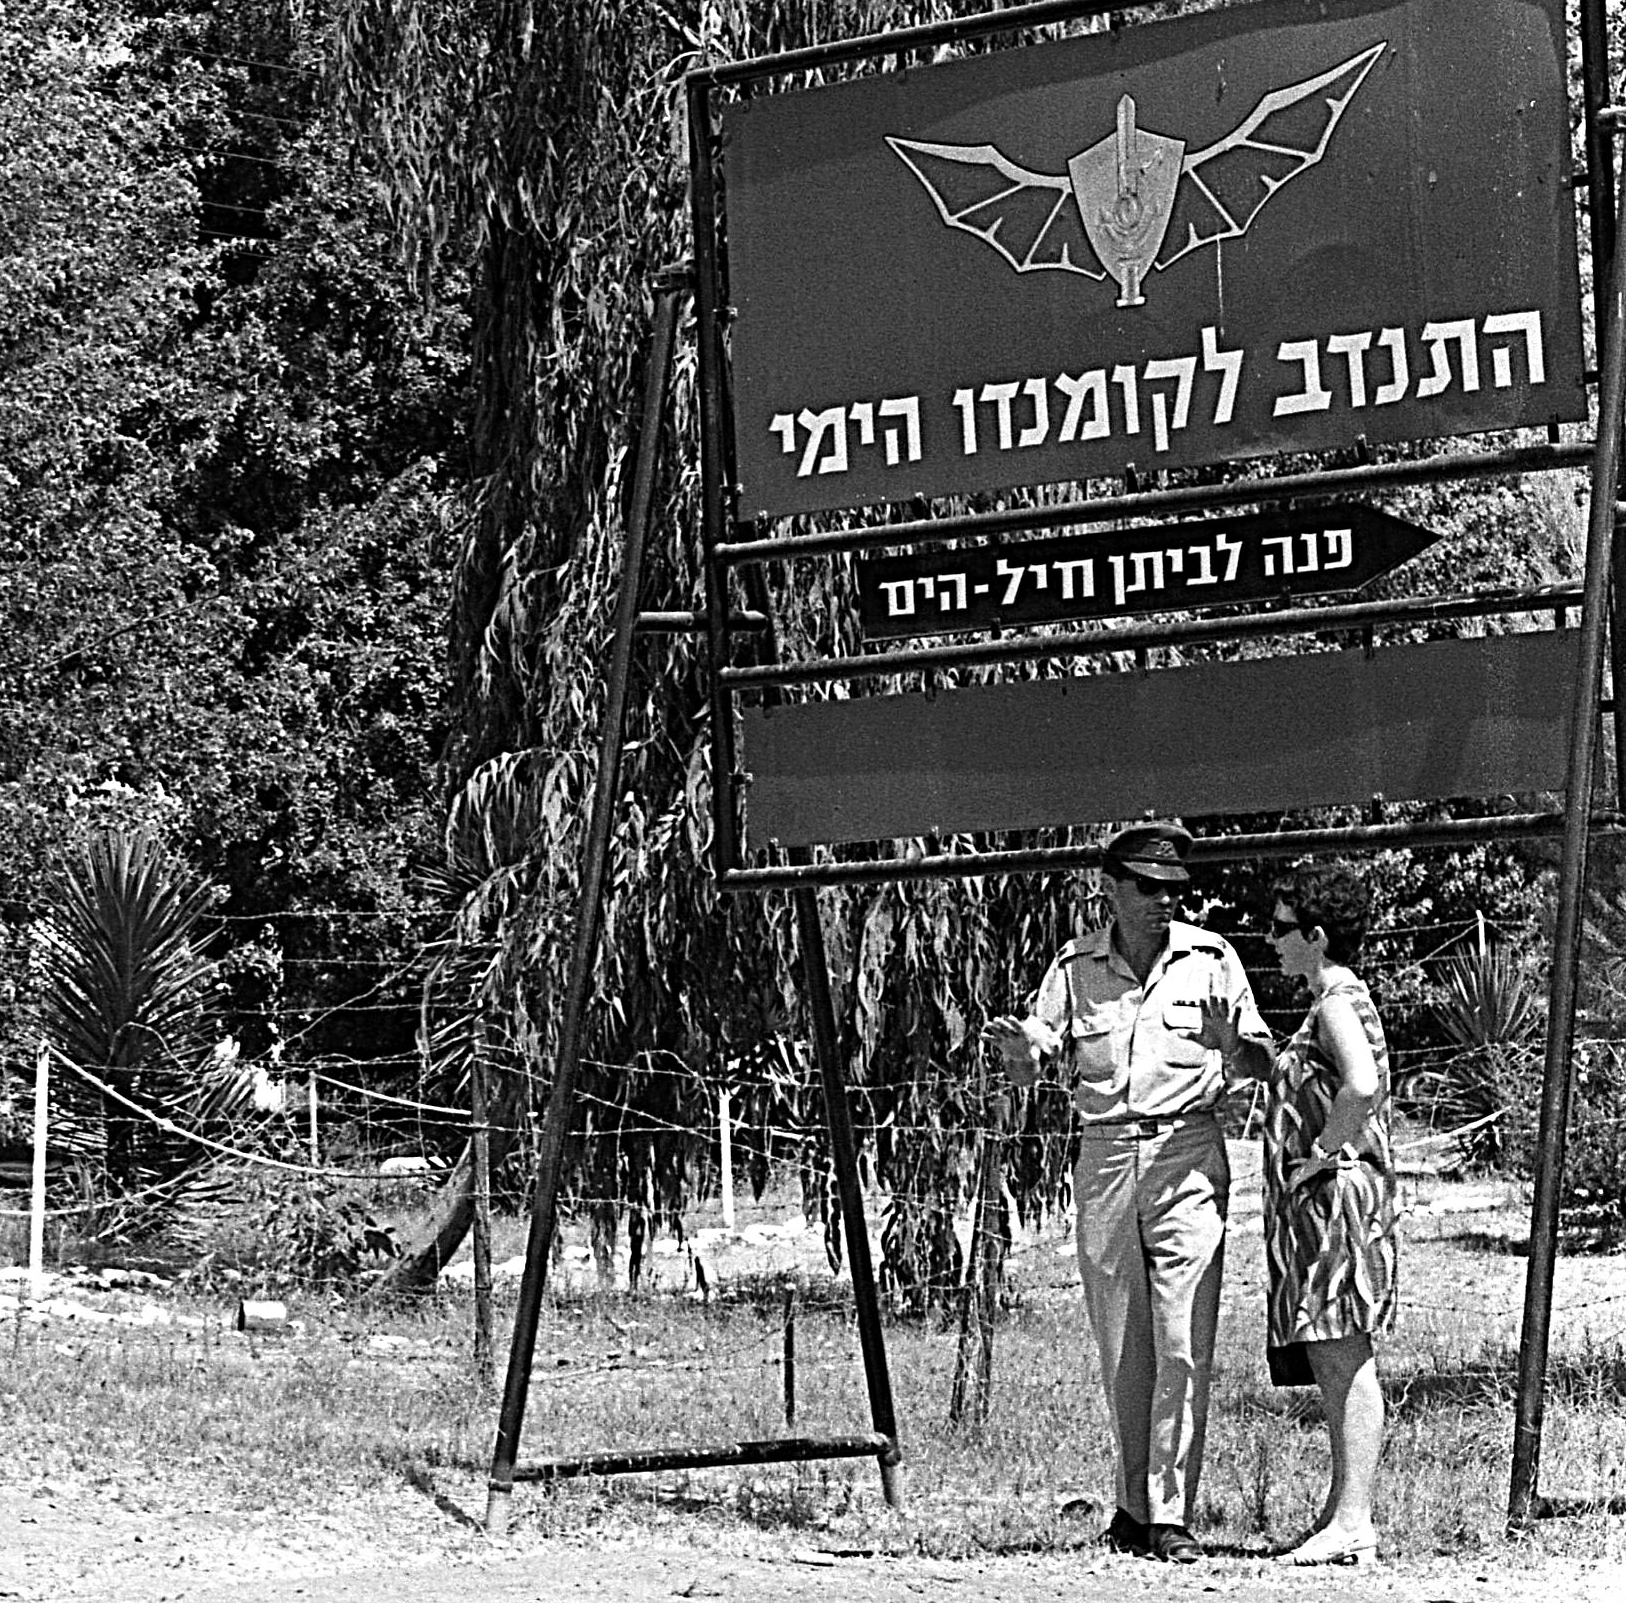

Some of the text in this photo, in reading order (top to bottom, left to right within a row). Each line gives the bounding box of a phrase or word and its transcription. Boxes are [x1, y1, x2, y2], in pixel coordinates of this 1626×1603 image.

[769, 310, 1545, 477] התנדב לקומנדו הימי
[879, 529, 1352, 616] פנה לביתן חיל-הים
